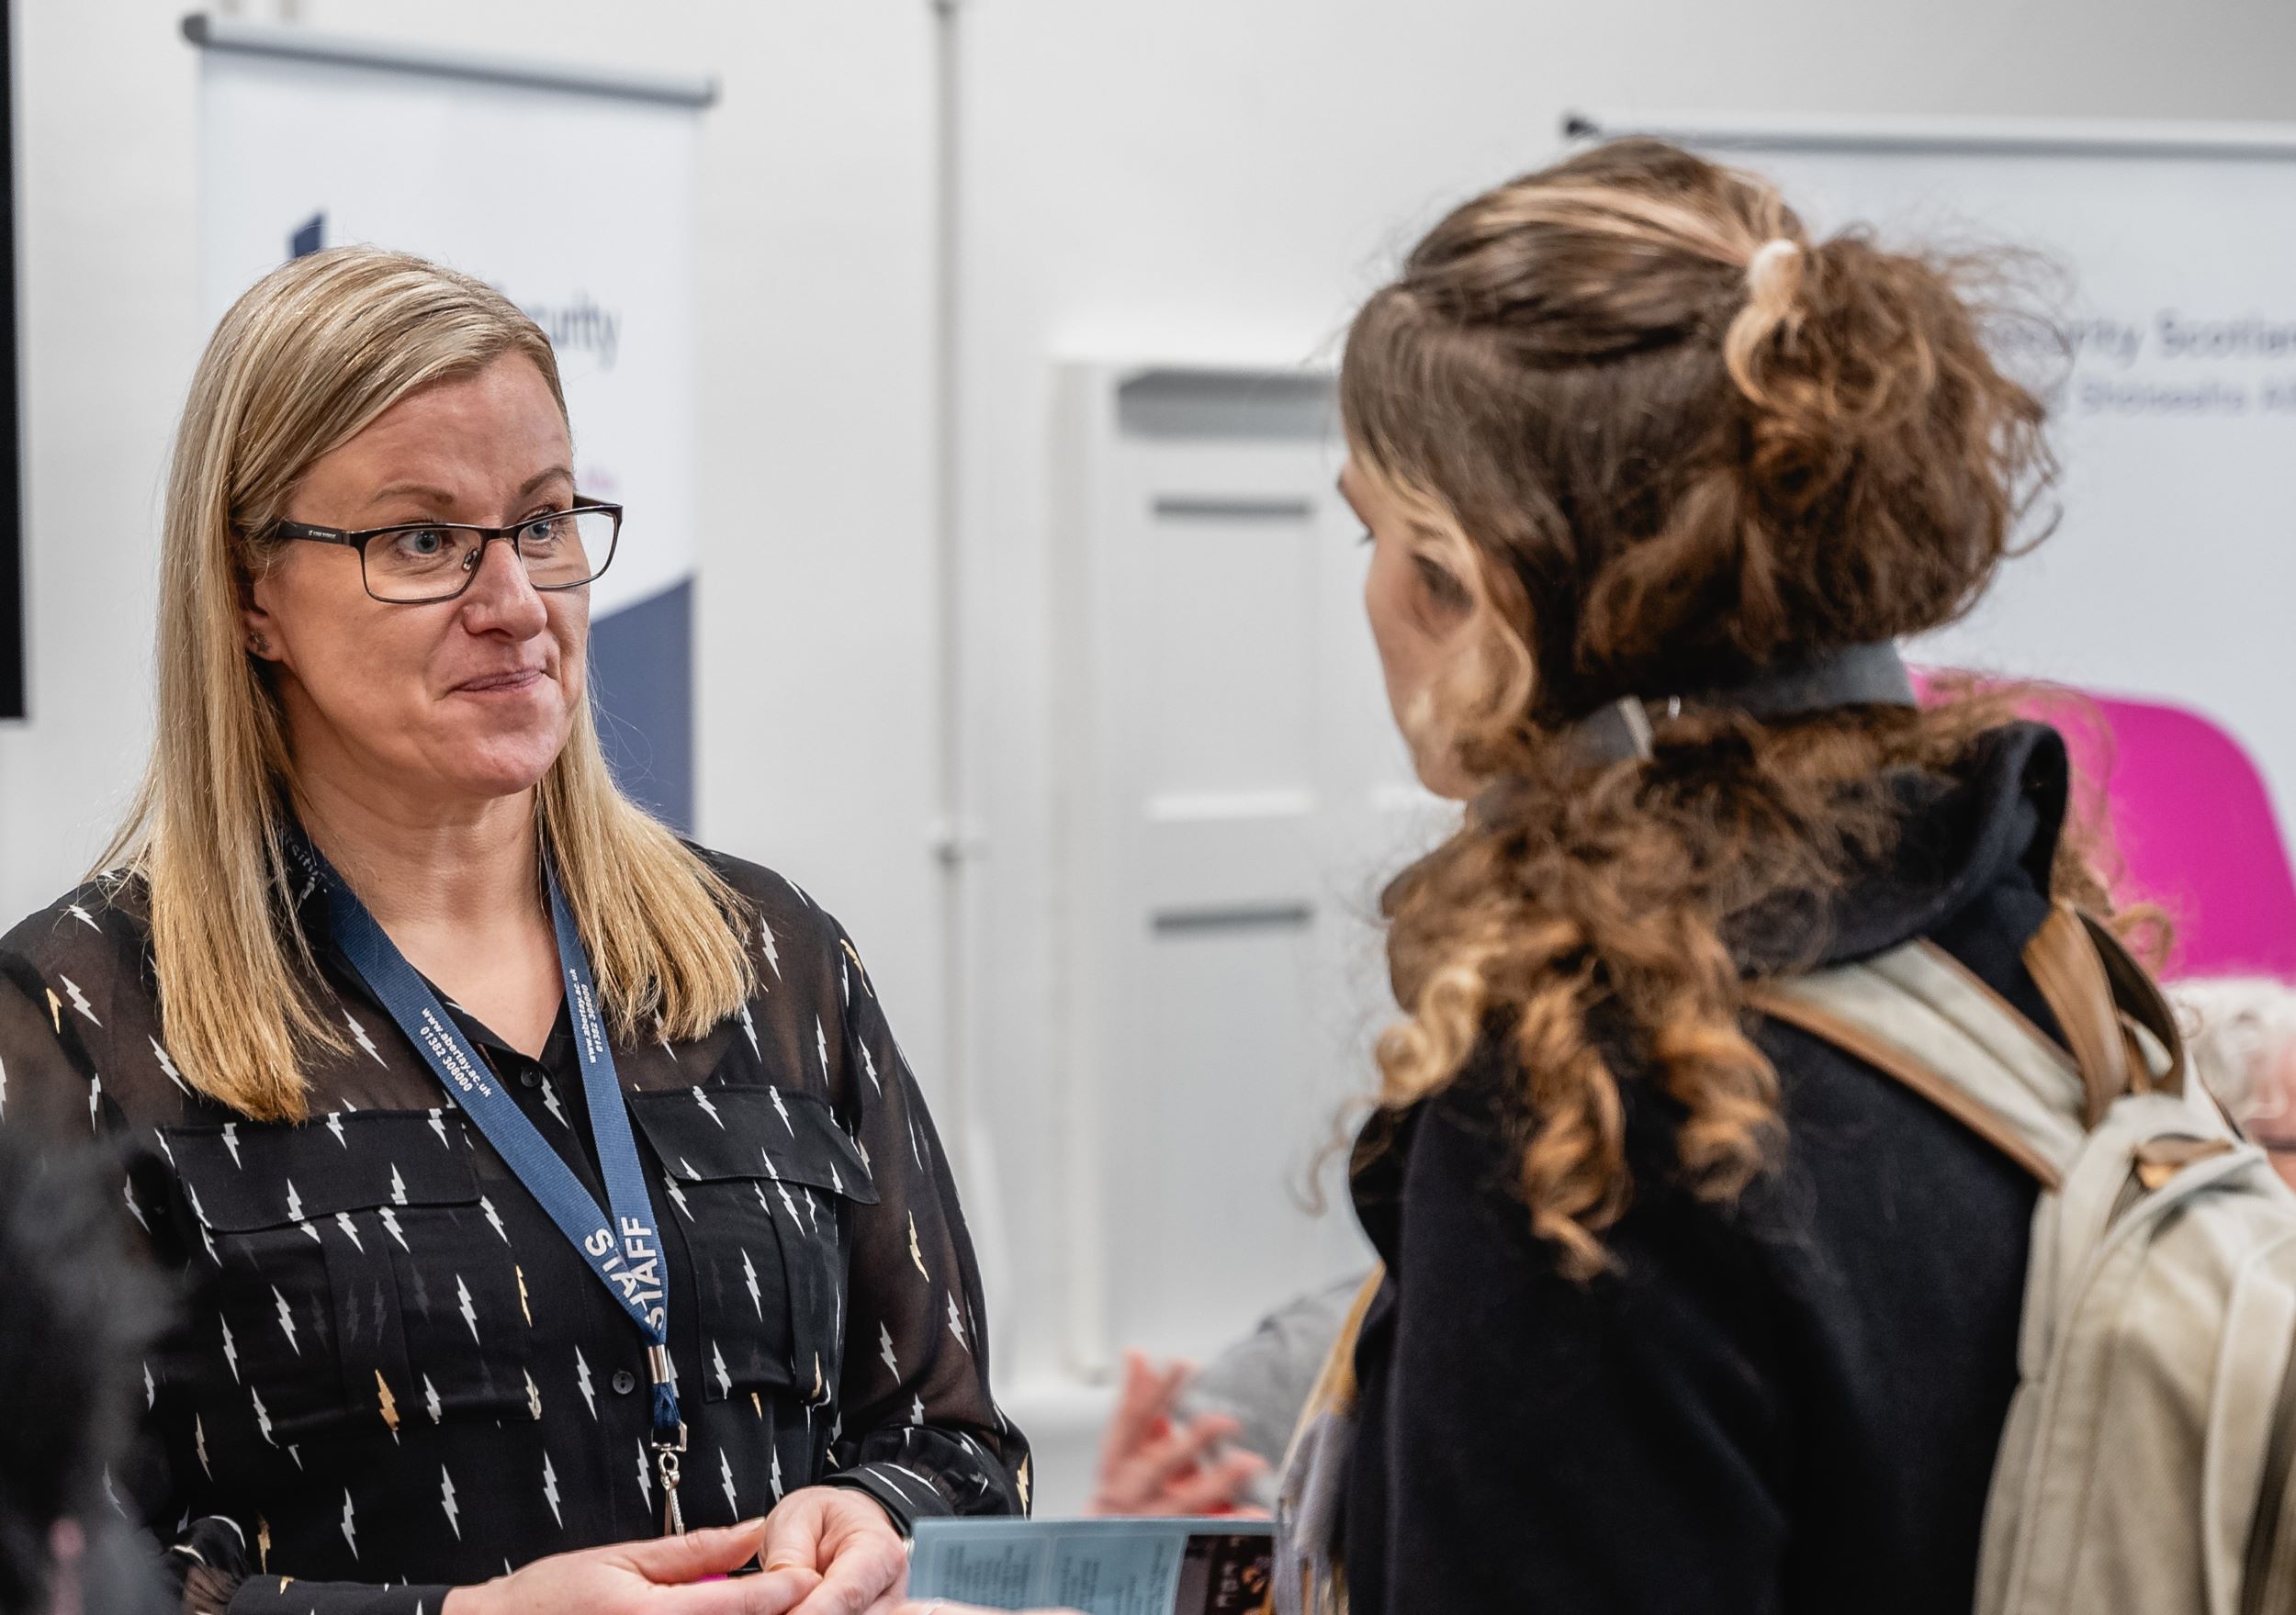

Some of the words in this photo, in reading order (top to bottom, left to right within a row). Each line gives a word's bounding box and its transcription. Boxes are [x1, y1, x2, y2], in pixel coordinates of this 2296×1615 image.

[420, 1026, 447, 1058] 01382
[442, 1056, 473, 1092] 308000
[422, 1007, 492, 1098] www.abertay.ac.uk
[621, 1217, 665, 1330] STAFF
